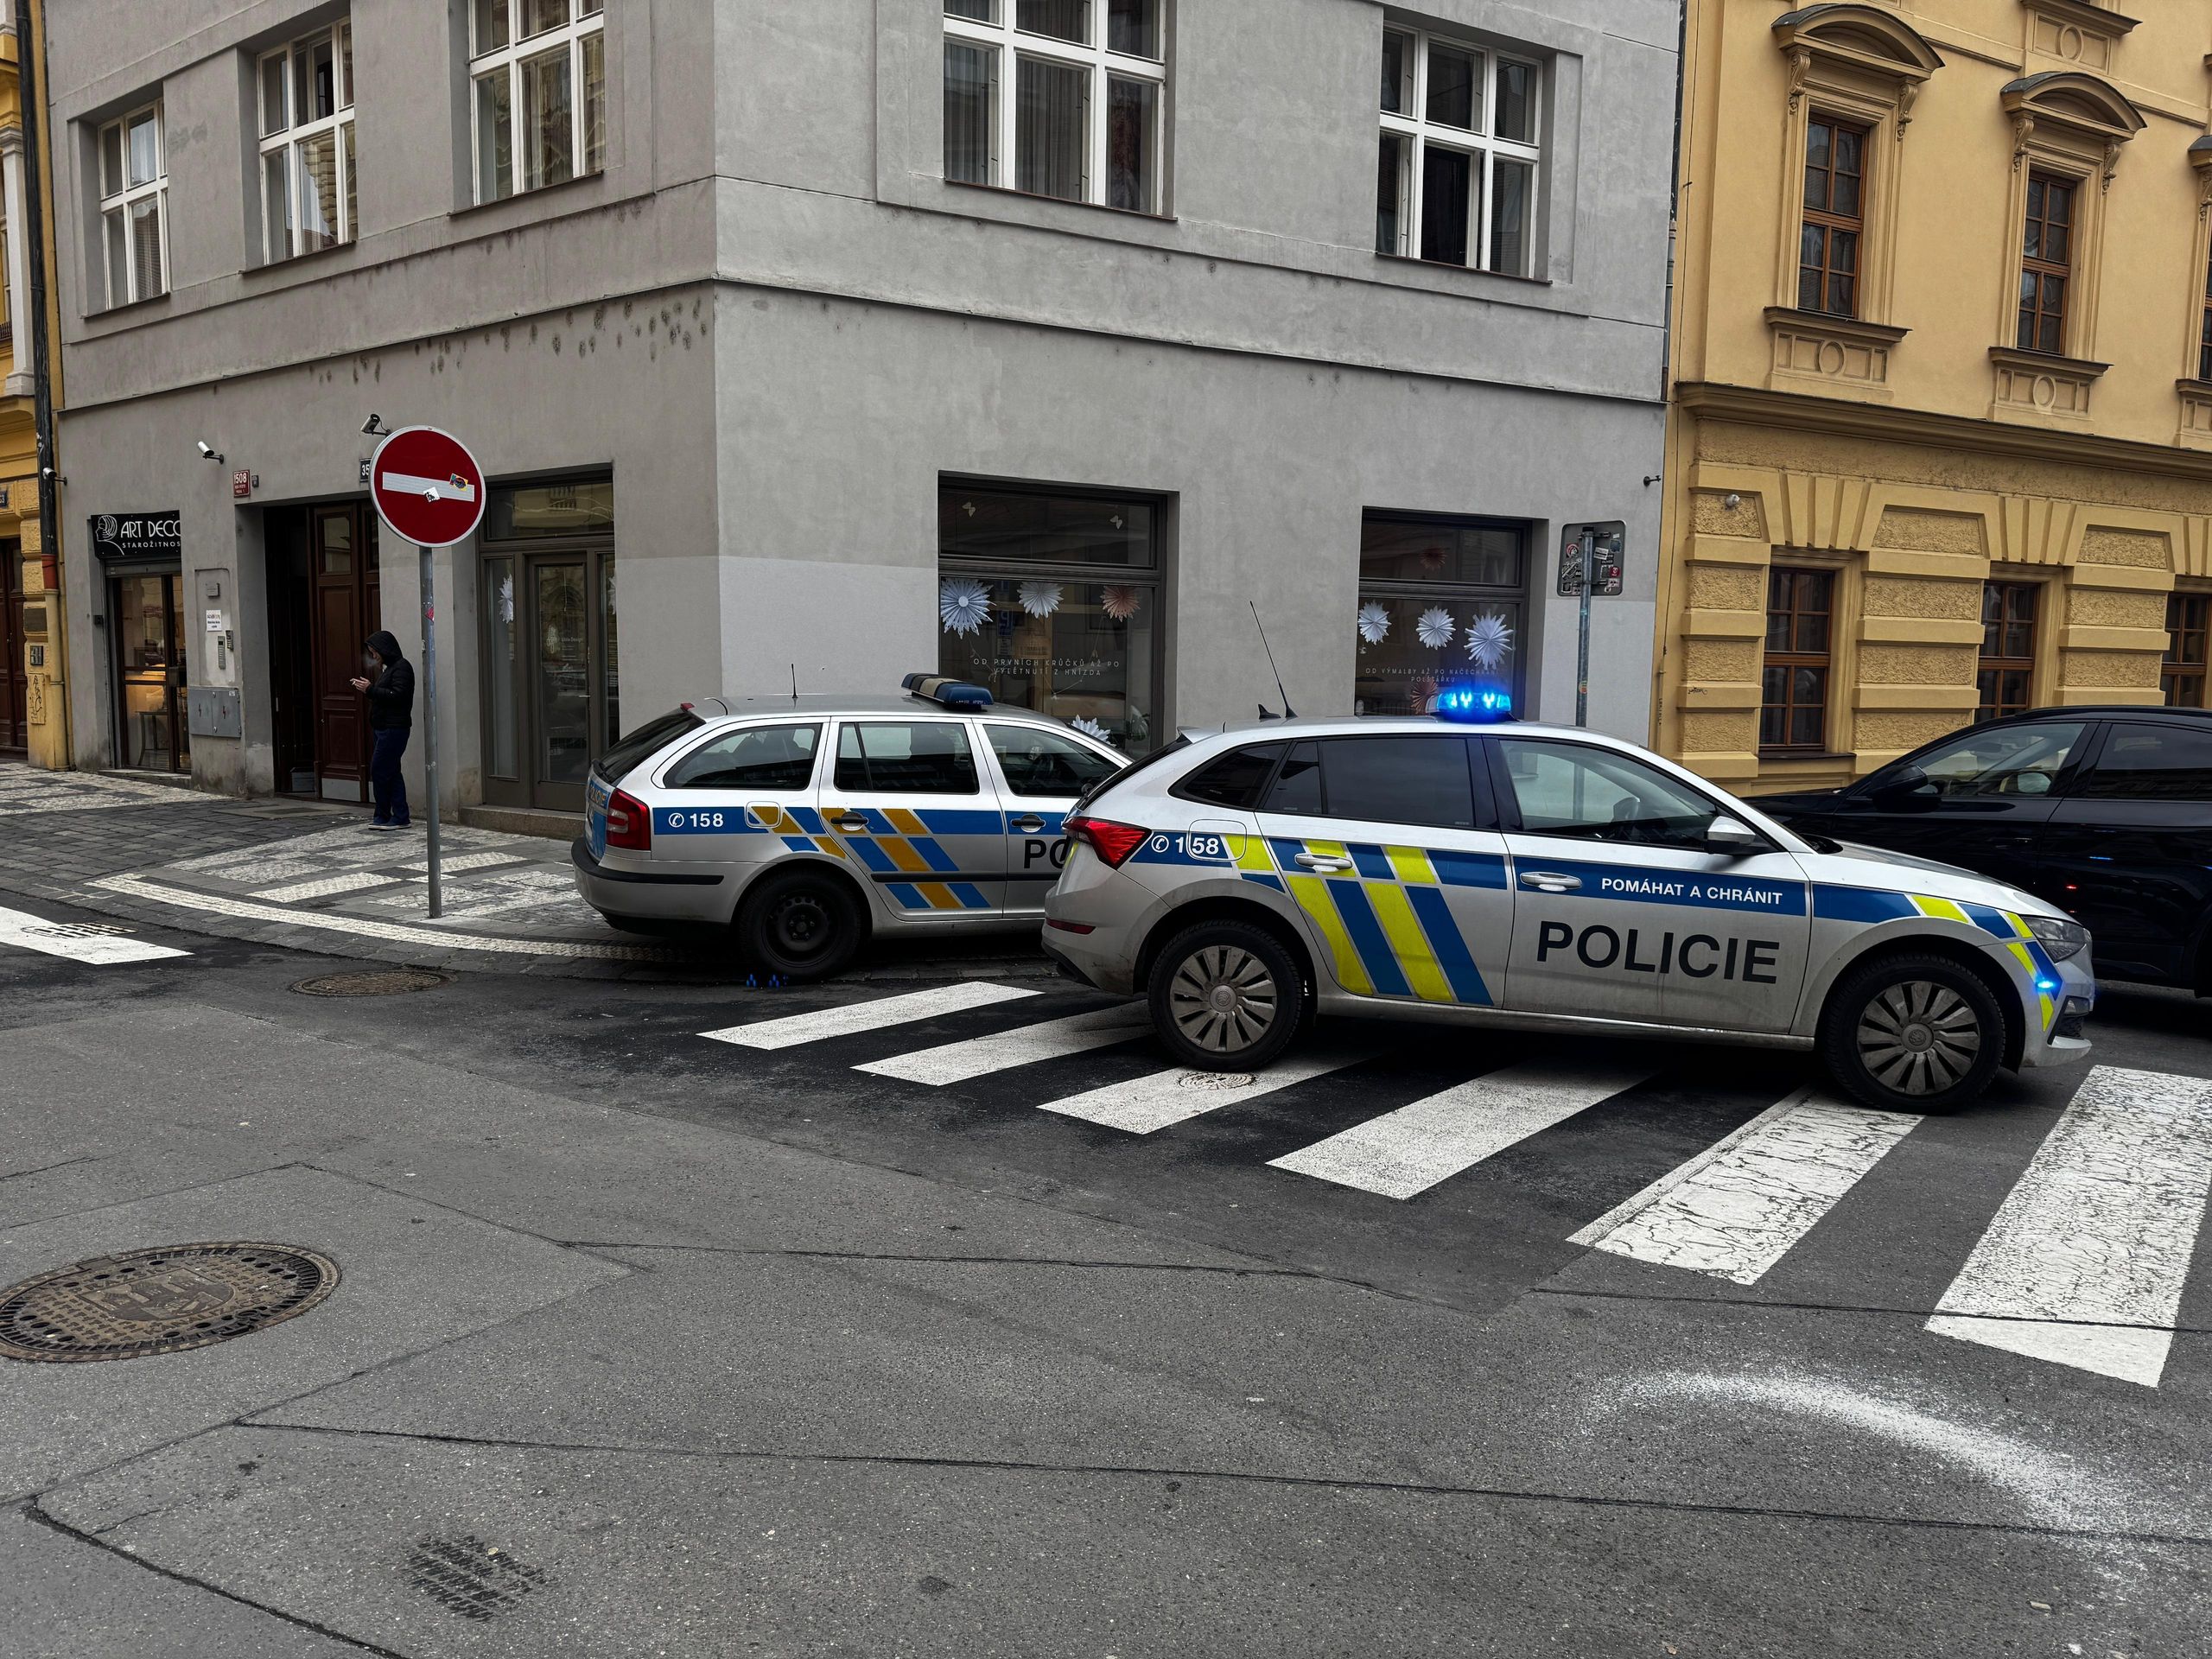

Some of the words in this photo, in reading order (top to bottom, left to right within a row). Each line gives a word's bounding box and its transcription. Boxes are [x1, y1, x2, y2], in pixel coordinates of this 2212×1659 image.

[121, 520, 143, 537] ART
[994, 658, 1039, 666] PRVNÍCH
[1045, 658, 1084, 667] KRŮČKŮ
[690, 812, 724, 828] 158
[1175, 836, 1219, 855] 158
[1601, 877, 1684, 897] POMÁHAT
[1689, 886, 1701, 899] A
[1707, 887, 1783, 905] CHRÁNIT
[1536, 920, 1780, 984] POLICIE
